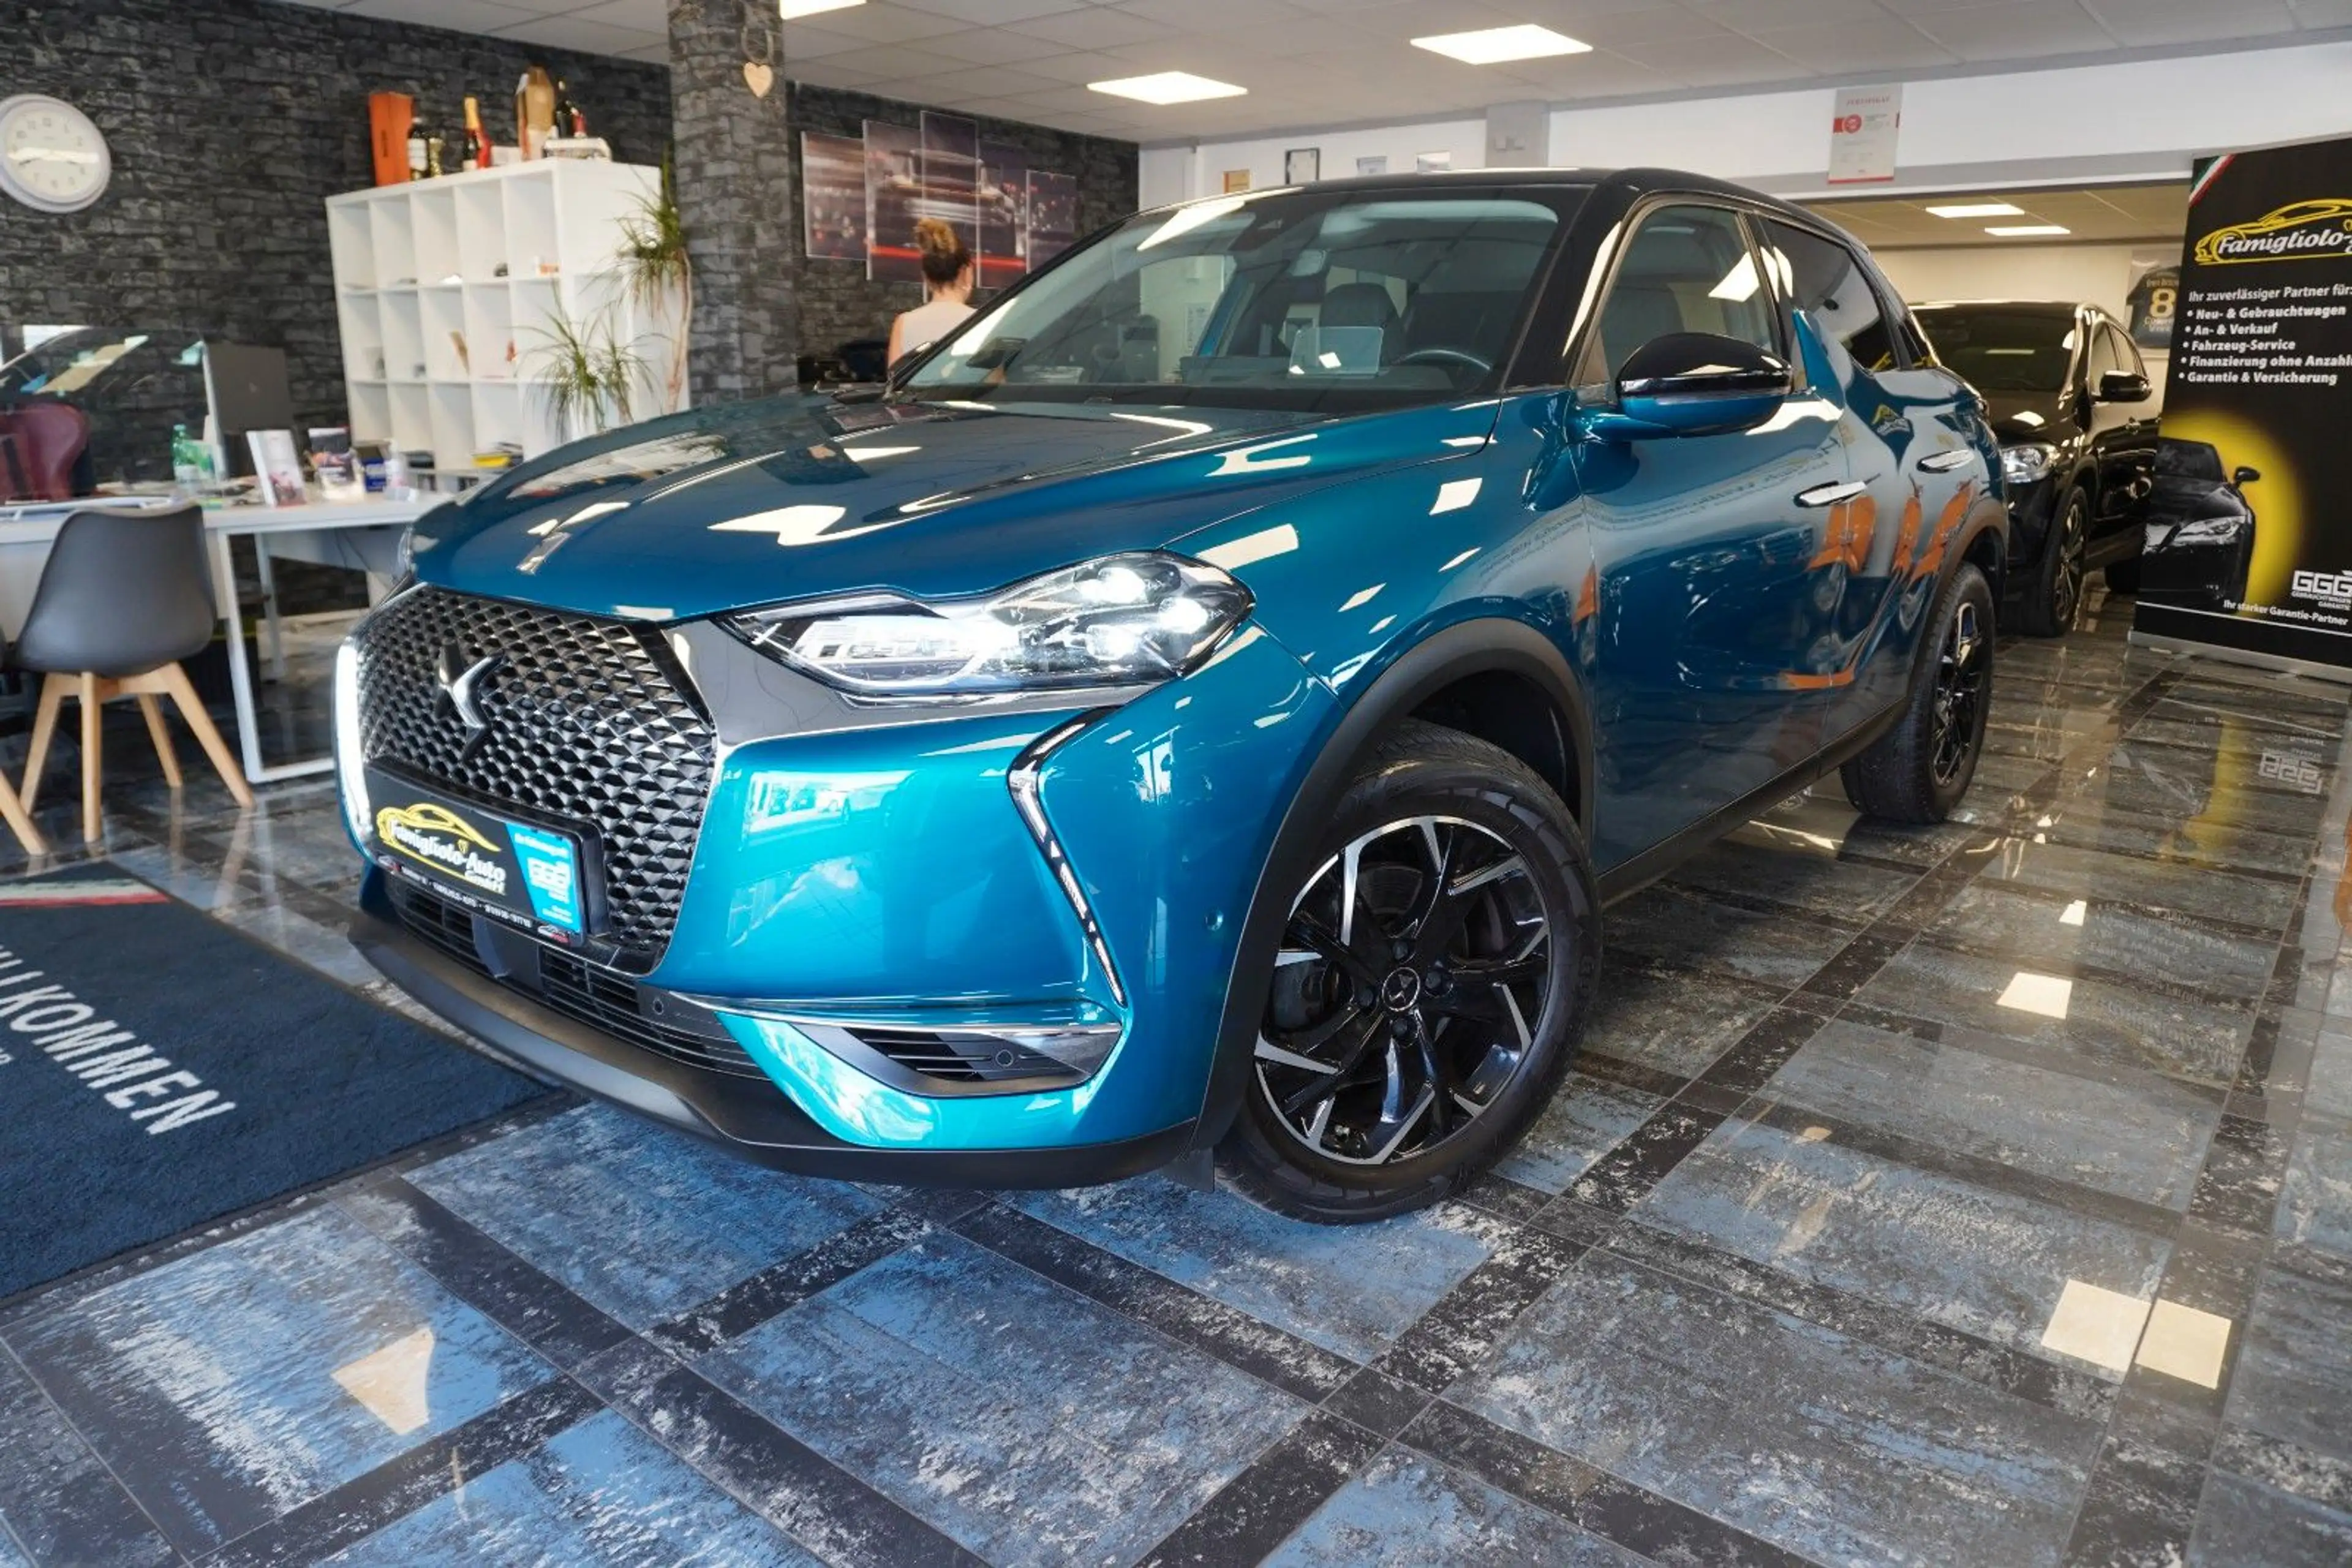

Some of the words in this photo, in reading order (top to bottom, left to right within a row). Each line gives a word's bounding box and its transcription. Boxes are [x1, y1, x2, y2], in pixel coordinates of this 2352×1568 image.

[2218, 228, 2352, 254] Famigliolo-
[2150, 288, 2176, 318] 8
[2189, 291, 2204, 303] Ihr
[2206, 288, 2280, 304] zuverlässiger
[2283, 286, 2330, 298] Partner
[2196, 310, 2223, 320] Neu-
[2227, 309, 2236, 319] &
[2239, 306, 2346, 318] Gebrauchtwagen
[2194, 325, 2214, 336] An-
[2217, 325, 2226, 335] &
[2230, 322, 2278, 335] Verkauf
[2192, 340, 2296, 353] Fahrzeug-Service
[2190, 356, 2266, 369] Finanzierung
[2271, 355, 2304, 366] ohne
[2306, 355, 2352, 367] Anzahl
[2188, 371, 2238, 383] Garantie
[2241, 372, 2250, 383] &
[2253, 372, 2338, 386] Versicherung
[2292, 570, 2352, 598] GGG
[2223, 600, 2236, 609] Ihr
[2270, 606, 2348, 625] Garantie-Partner
[0, 944, 236, 1136] KOMMEN
